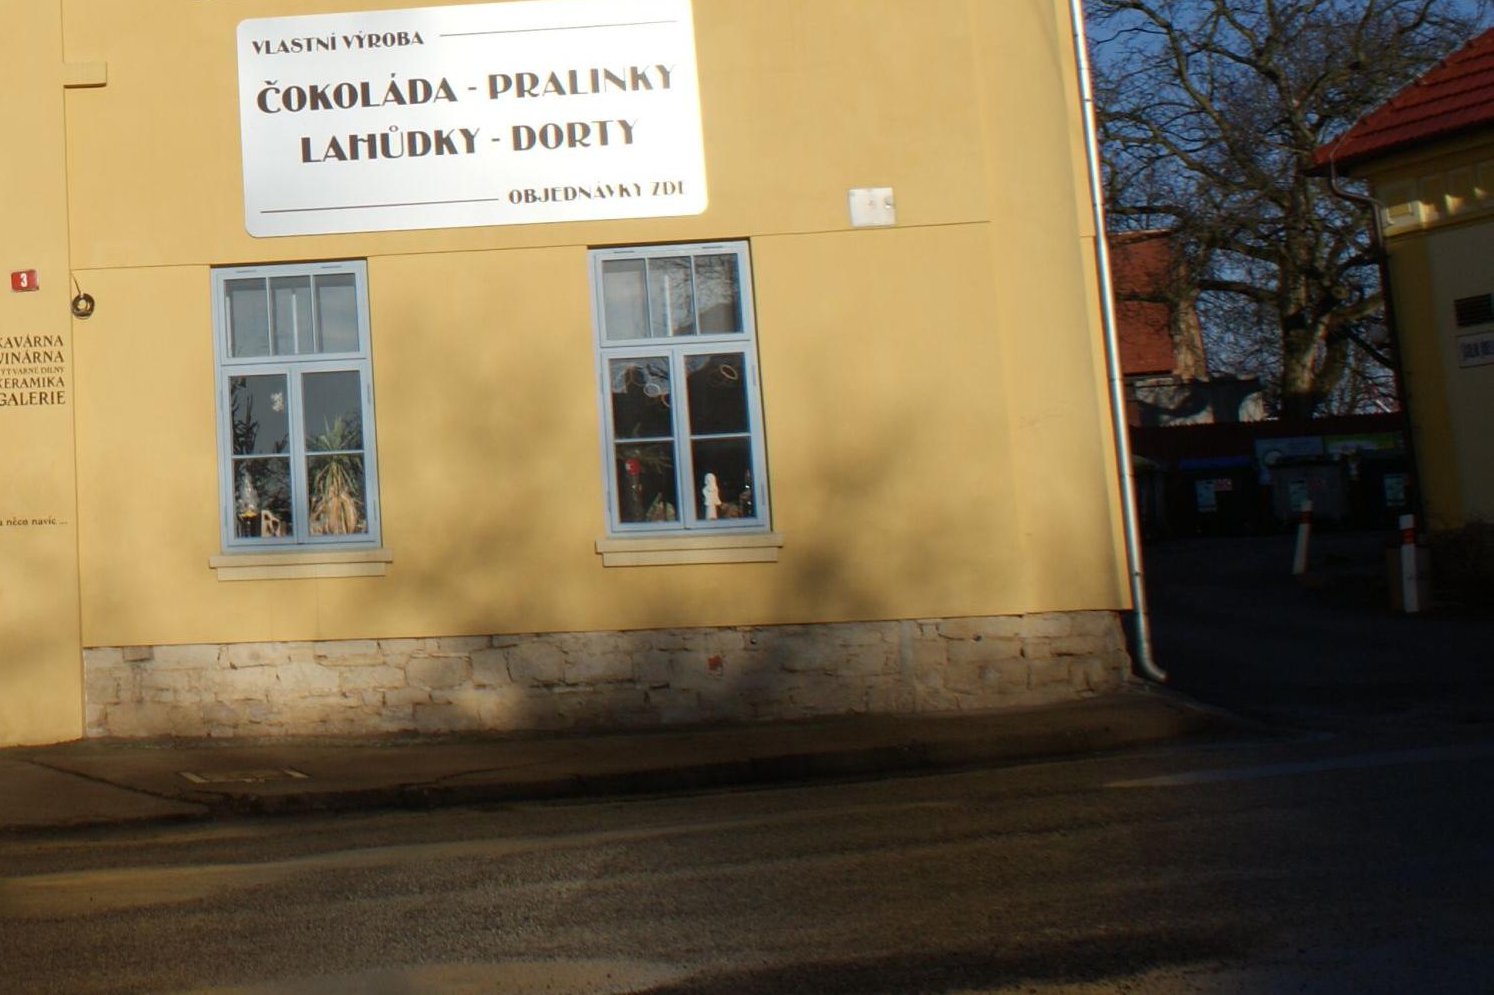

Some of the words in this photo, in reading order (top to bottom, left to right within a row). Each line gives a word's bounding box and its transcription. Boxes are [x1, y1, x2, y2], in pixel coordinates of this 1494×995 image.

[252, 32, 337, 55] VLASTNÍ
[342, 30, 425, 49] VÝROBA
[257, 72, 459, 114] ČOKOLÁDA
[488, 63, 676, 100] PRALINKY
[301, 124, 481, 163] LAHŮDKY
[512, 118, 638, 152] DORTY
[508, 180, 643, 205] OBJEDNÁVKY
[19, 272, 28, 288] 3
